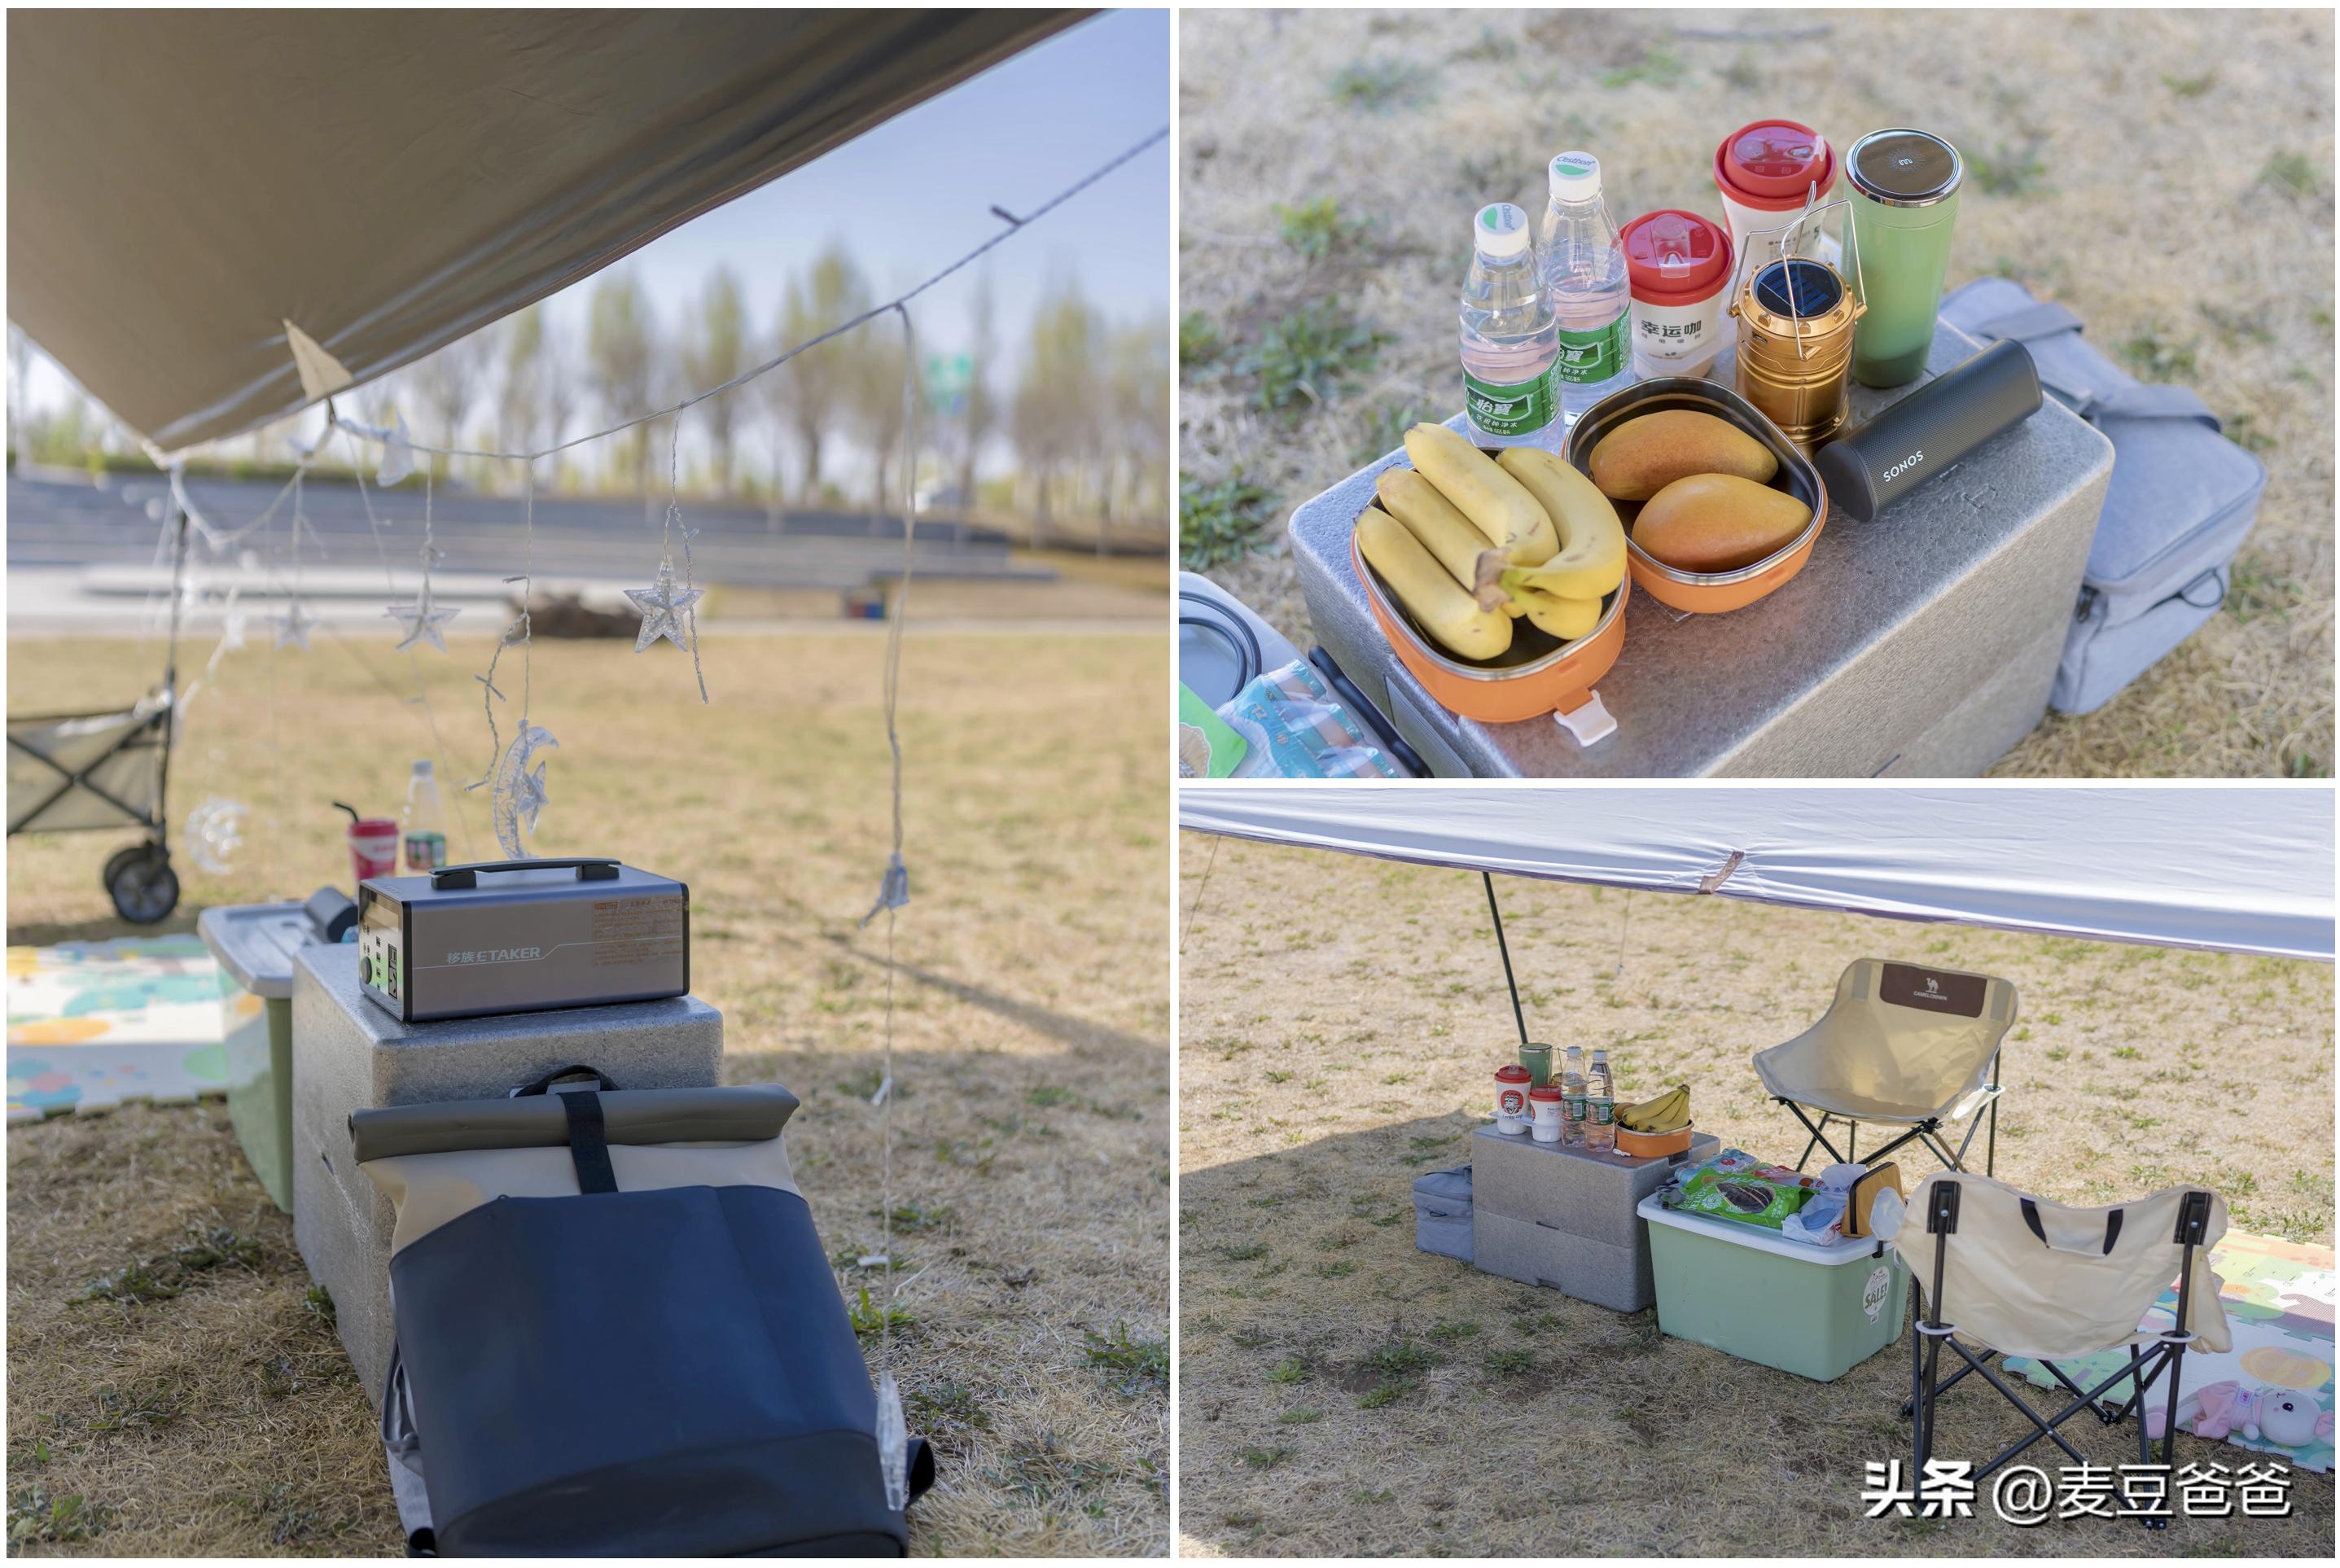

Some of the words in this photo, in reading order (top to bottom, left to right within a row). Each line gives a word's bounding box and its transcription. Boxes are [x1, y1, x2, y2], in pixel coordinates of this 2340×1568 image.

[1641, 320, 1702, 338] 幸运咖
[1883, 450, 1924, 482] SONOS
[1864, 1282, 1889, 1310] SALE!
